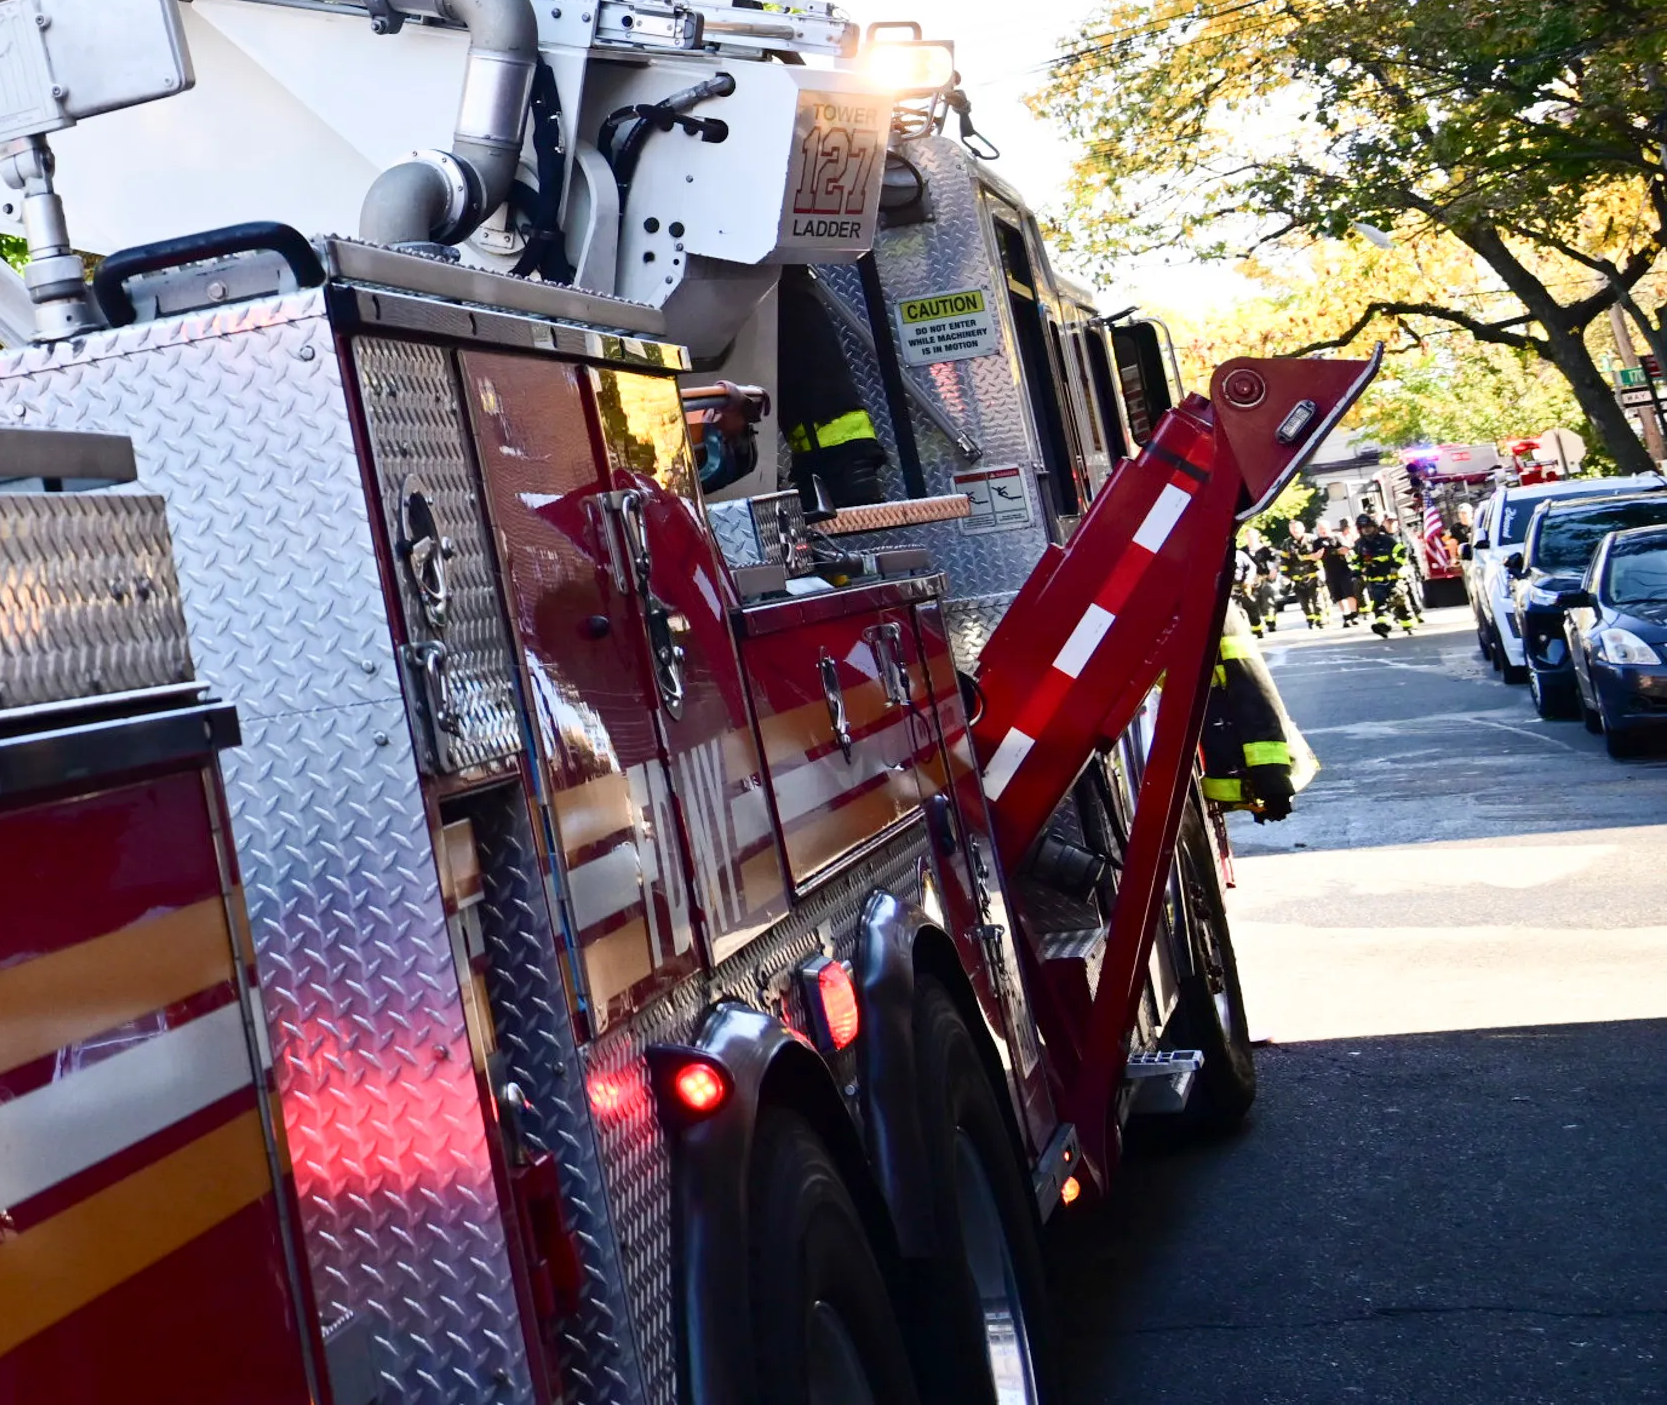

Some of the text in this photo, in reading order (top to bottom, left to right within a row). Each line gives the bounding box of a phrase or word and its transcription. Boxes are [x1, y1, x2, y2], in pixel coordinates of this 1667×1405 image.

[813, 103, 878, 123] TOWER
[793, 126, 879, 215] 127
[792, 219, 861, 239] LADDER
[907, 294, 978, 319] CAUTION
[908, 328, 988, 347] WHILE MACHINERY
[915, 319, 977, 336] DO NOT ENTER
[921, 340, 979, 356] IS IN MOTION
